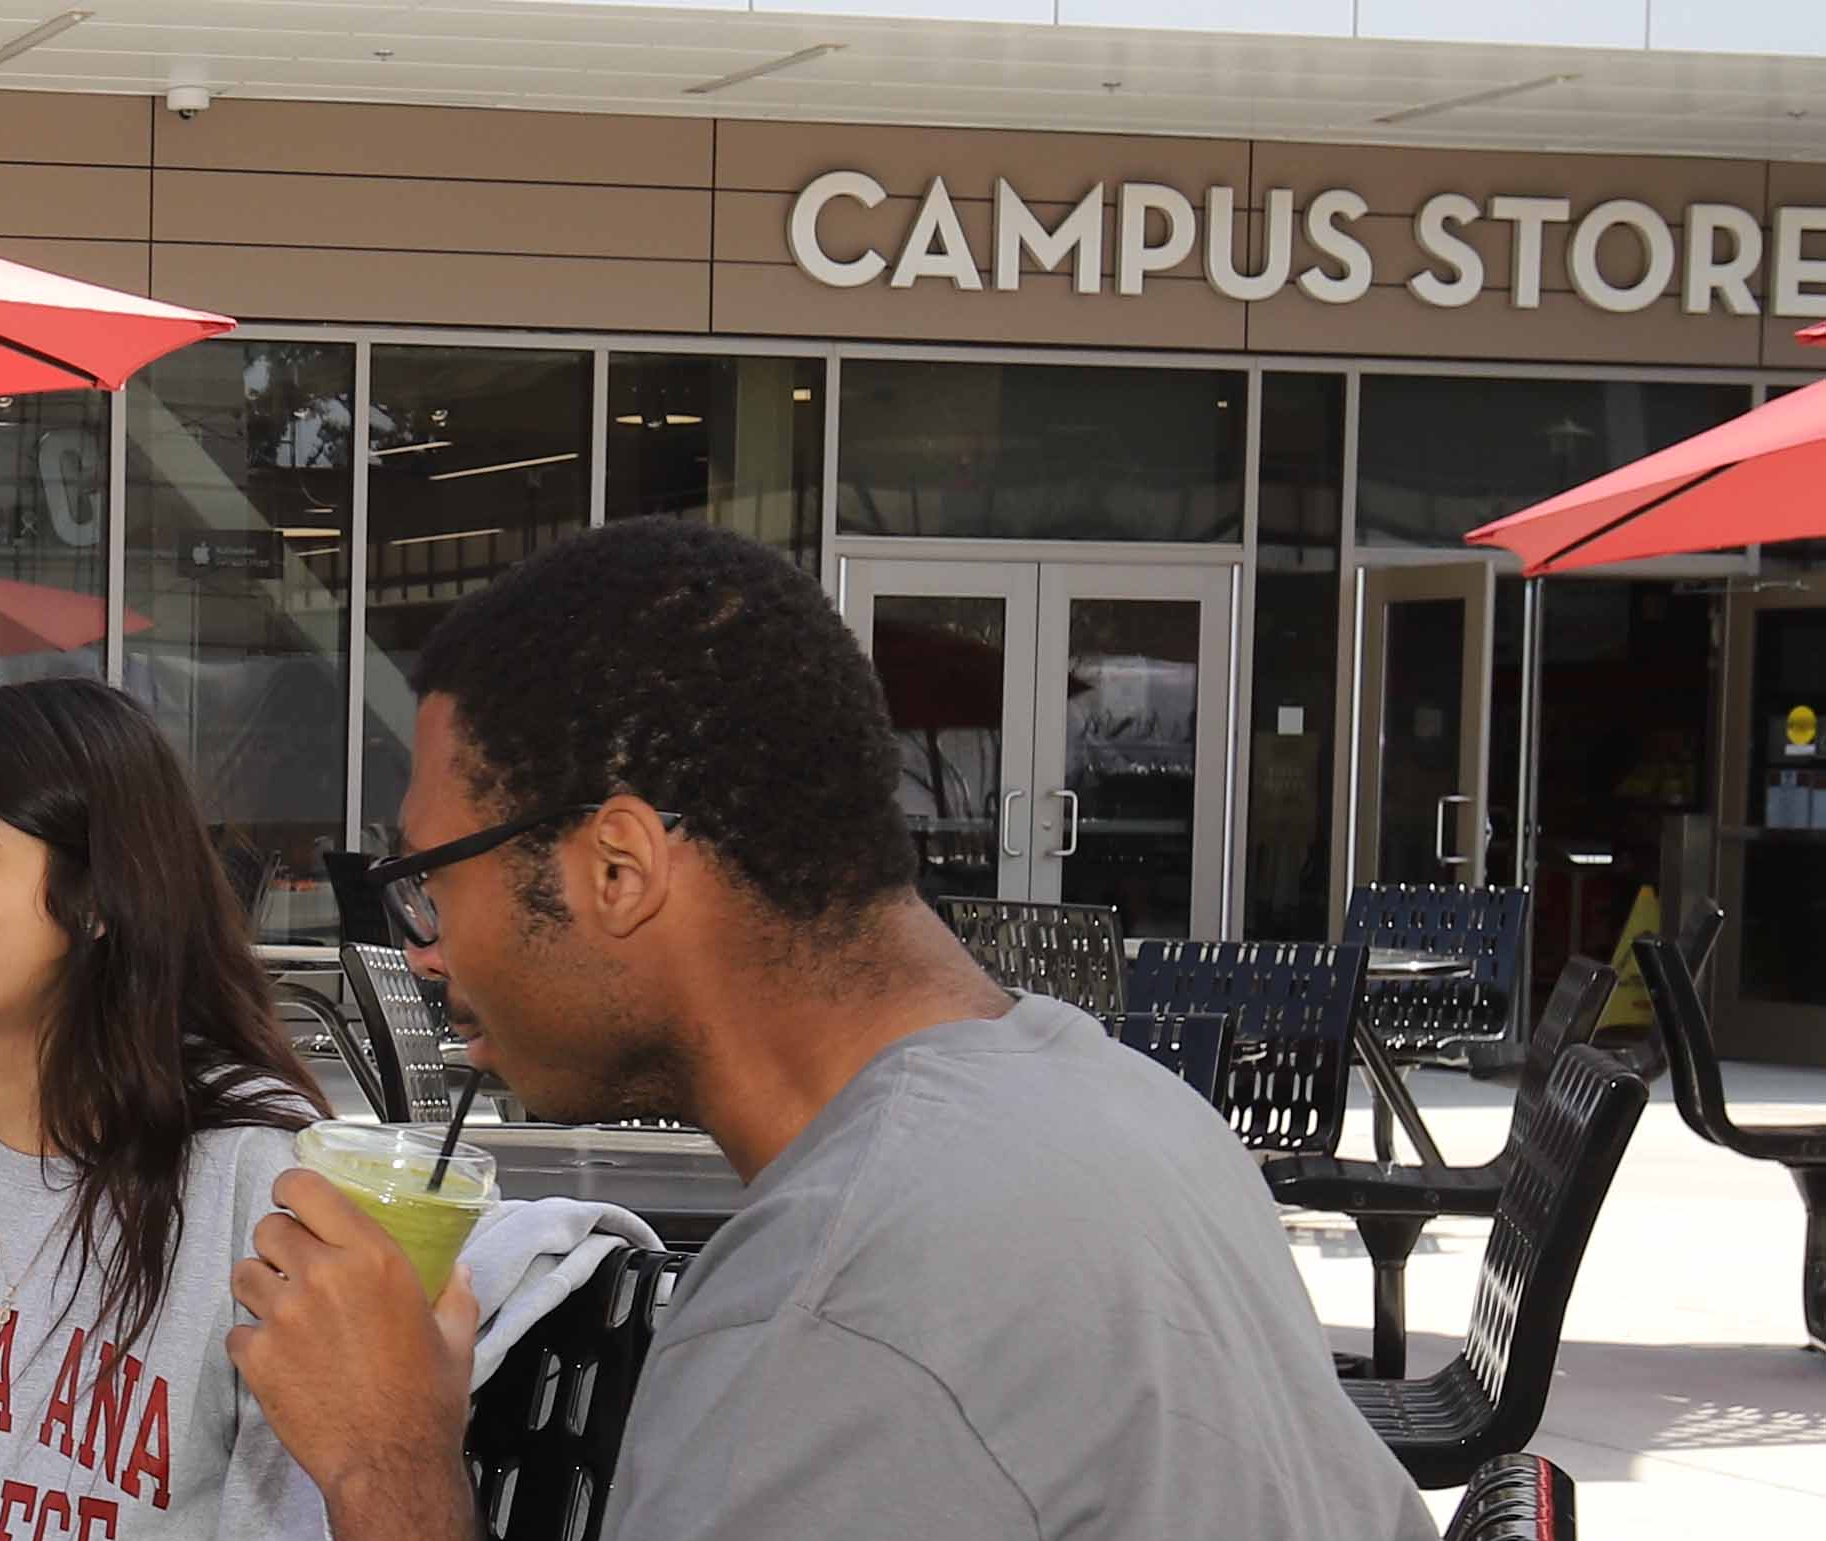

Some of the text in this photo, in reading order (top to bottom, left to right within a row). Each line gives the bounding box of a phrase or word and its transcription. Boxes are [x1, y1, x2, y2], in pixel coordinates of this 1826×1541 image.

[788, 170, 1826, 318] CAMPUS STORE
[39, 1327, 172, 1510] ANA
